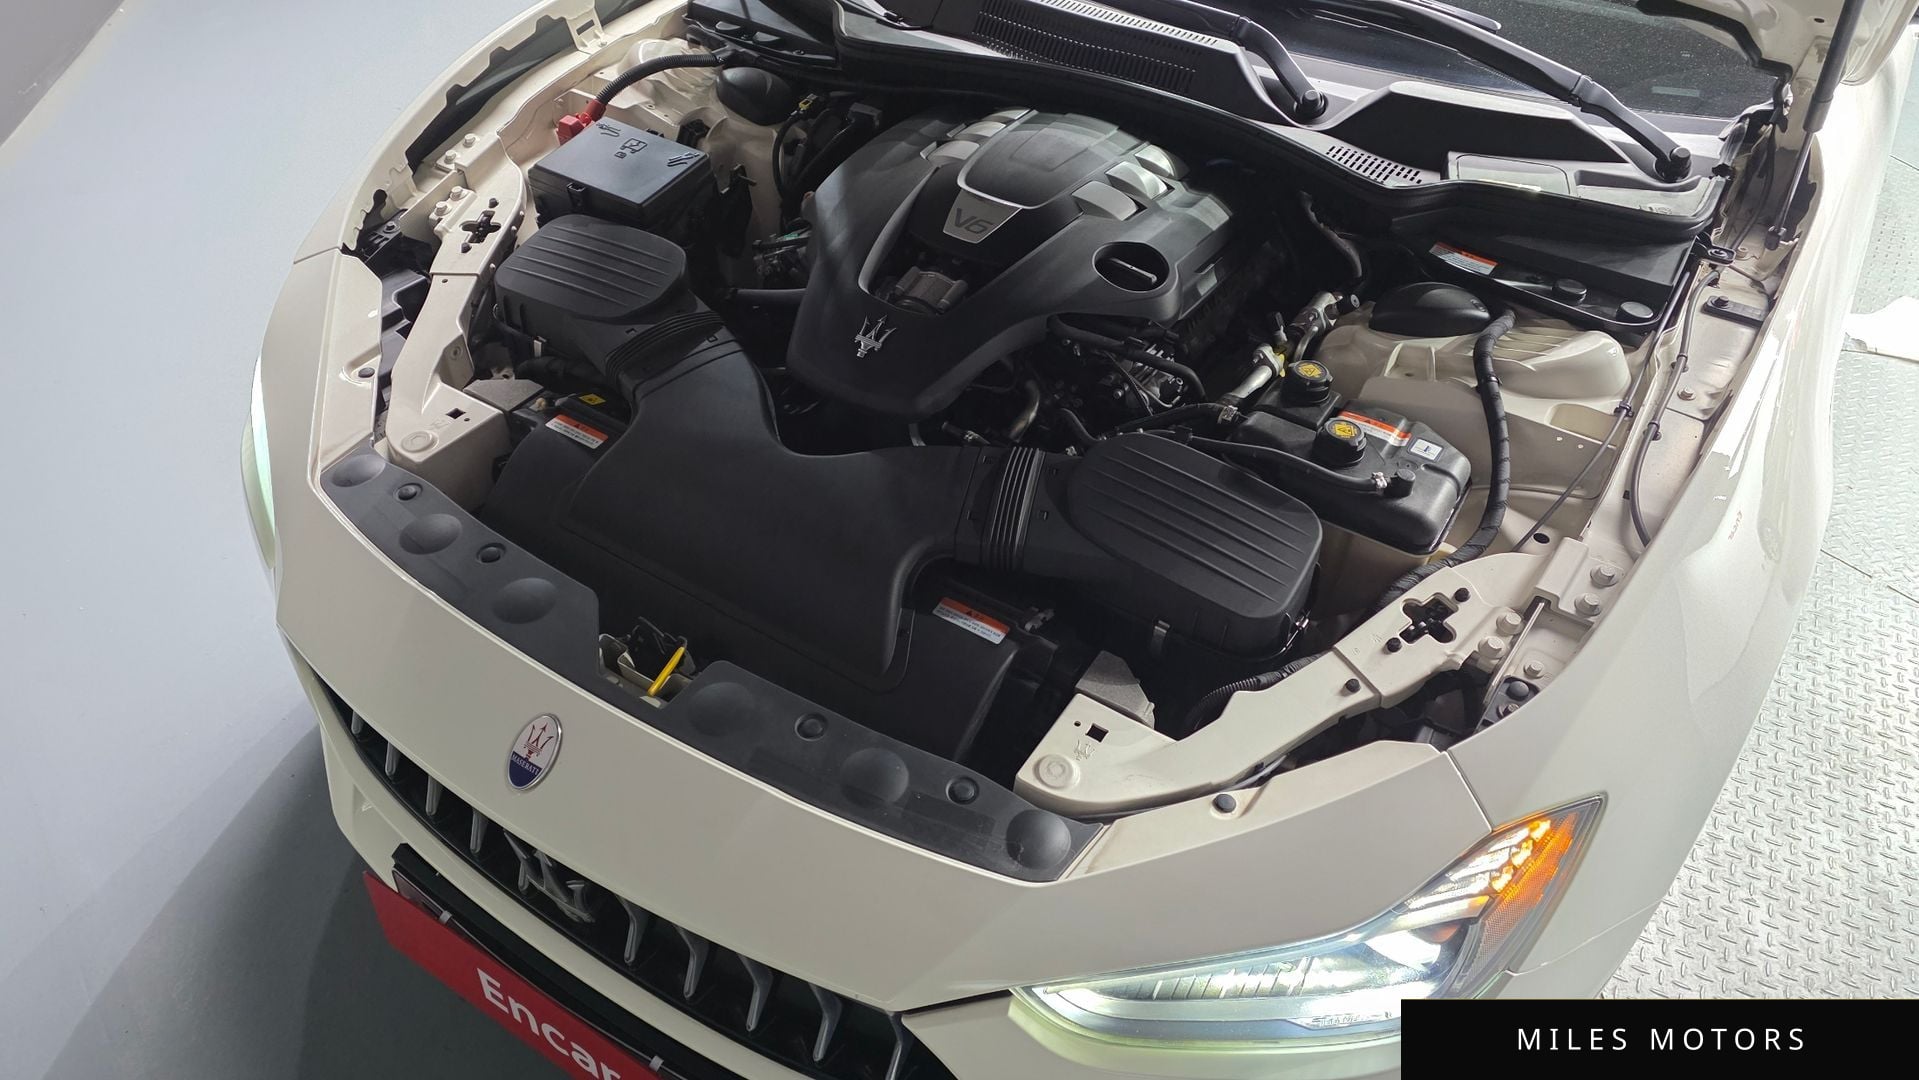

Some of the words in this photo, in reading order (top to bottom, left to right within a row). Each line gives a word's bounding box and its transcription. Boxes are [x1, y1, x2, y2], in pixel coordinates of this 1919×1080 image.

[955, 208, 994, 234] V6
[511, 753, 540, 775] MASERATI
[477, 967, 621, 1080] Encar
